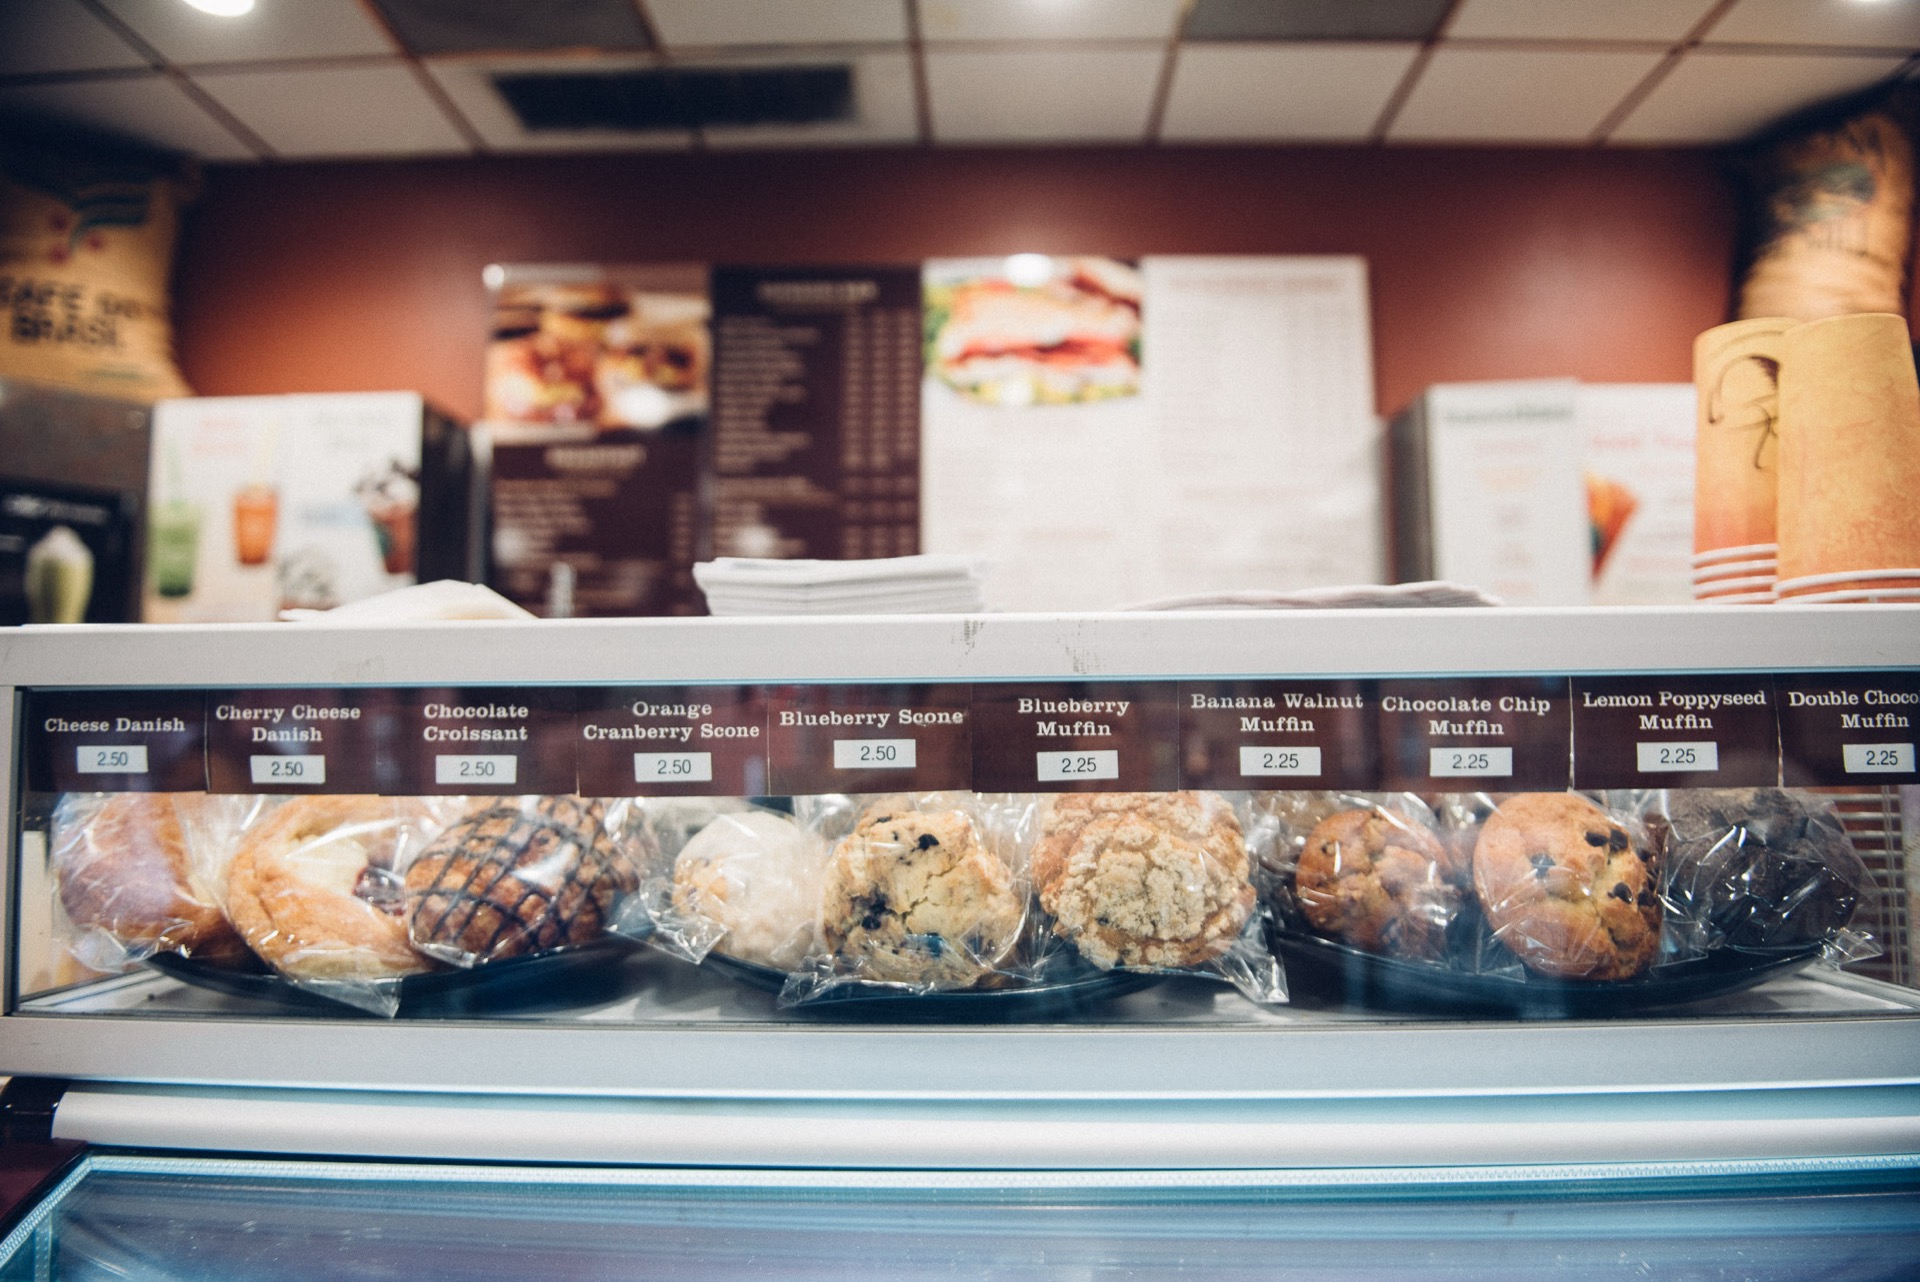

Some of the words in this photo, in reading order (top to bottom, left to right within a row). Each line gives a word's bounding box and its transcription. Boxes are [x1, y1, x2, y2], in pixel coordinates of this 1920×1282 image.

[1190, 694, 1275, 709] Banana
[1283, 693, 1363, 708] Walnut
[1382, 696, 1491, 712] Chocolate
[1499, 697, 1551, 715] Chip
[1584, 691, 1652, 707] Lemon
[1659, 691, 1766, 710] Poppyseed
[1789, 691, 1859, 707] Double
[1864, 689, 1920, 705] Choco
[216, 705, 285, 722] Cherry
[292, 705, 361, 719] Cheese
[424, 704, 528, 719] Chocolate
[632, 701, 712, 718] Orange
[1018, 698, 1130, 716] Blueberry
[45, 718, 110, 732] Cheese
[116, 717, 185, 732] Danish
[780, 711, 890, 728] Blueberry
[898, 709, 963, 725] Scone
[1240, 716, 1315, 732] Muffin
[1639, 715, 1713, 729] Muffin
[1841, 714, 1909, 728] Muffin
[252, 727, 322, 743] Danish
[423, 725, 528, 741] Croissant
[583, 724, 692, 741] Cranberry
[700, 723, 760, 738] Scone
[1037, 721, 1112, 736] Muffin
[1429, 719, 1504, 735] Muffin
[97, 752, 128, 767] 2.50
[860, 746, 897, 761] 2.50
[1263, 753, 1299, 768] 2.25
[1452, 753, 1489, 769] 2.25
[1660, 749, 1696, 764] 2.25
[1866, 751, 1898, 766] 2.25
[271, 762, 303, 776] 2.50
[459, 762, 496, 776] 2.50
[657, 759, 692, 775] 2.50
[1061, 757, 1097, 773] 2.25
